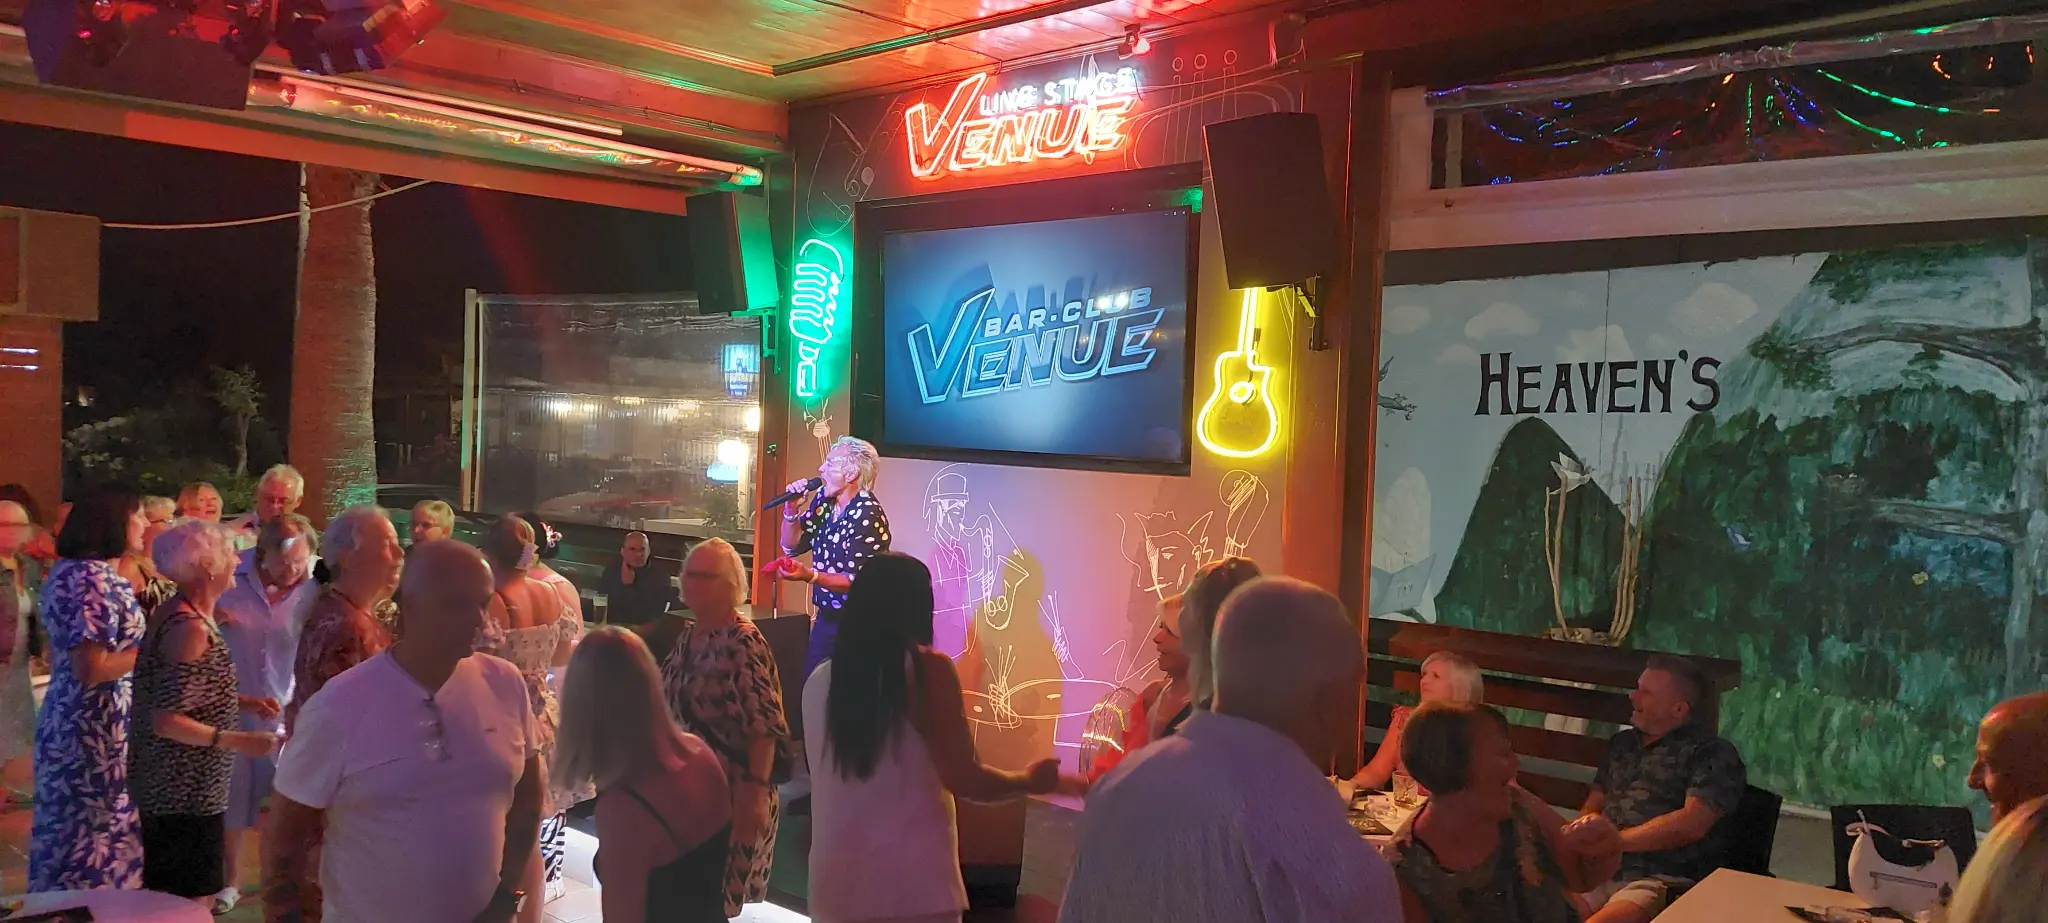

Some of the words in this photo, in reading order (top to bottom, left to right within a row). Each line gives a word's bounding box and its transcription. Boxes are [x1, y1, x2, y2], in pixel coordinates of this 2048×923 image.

[905, 72, 1137, 177] VENUE
[1044, 67, 1138, 105] STAGE
[907, 287, 1165, 404] VENUE
[1474, 349, 1722, 416] HEAVEN'S
